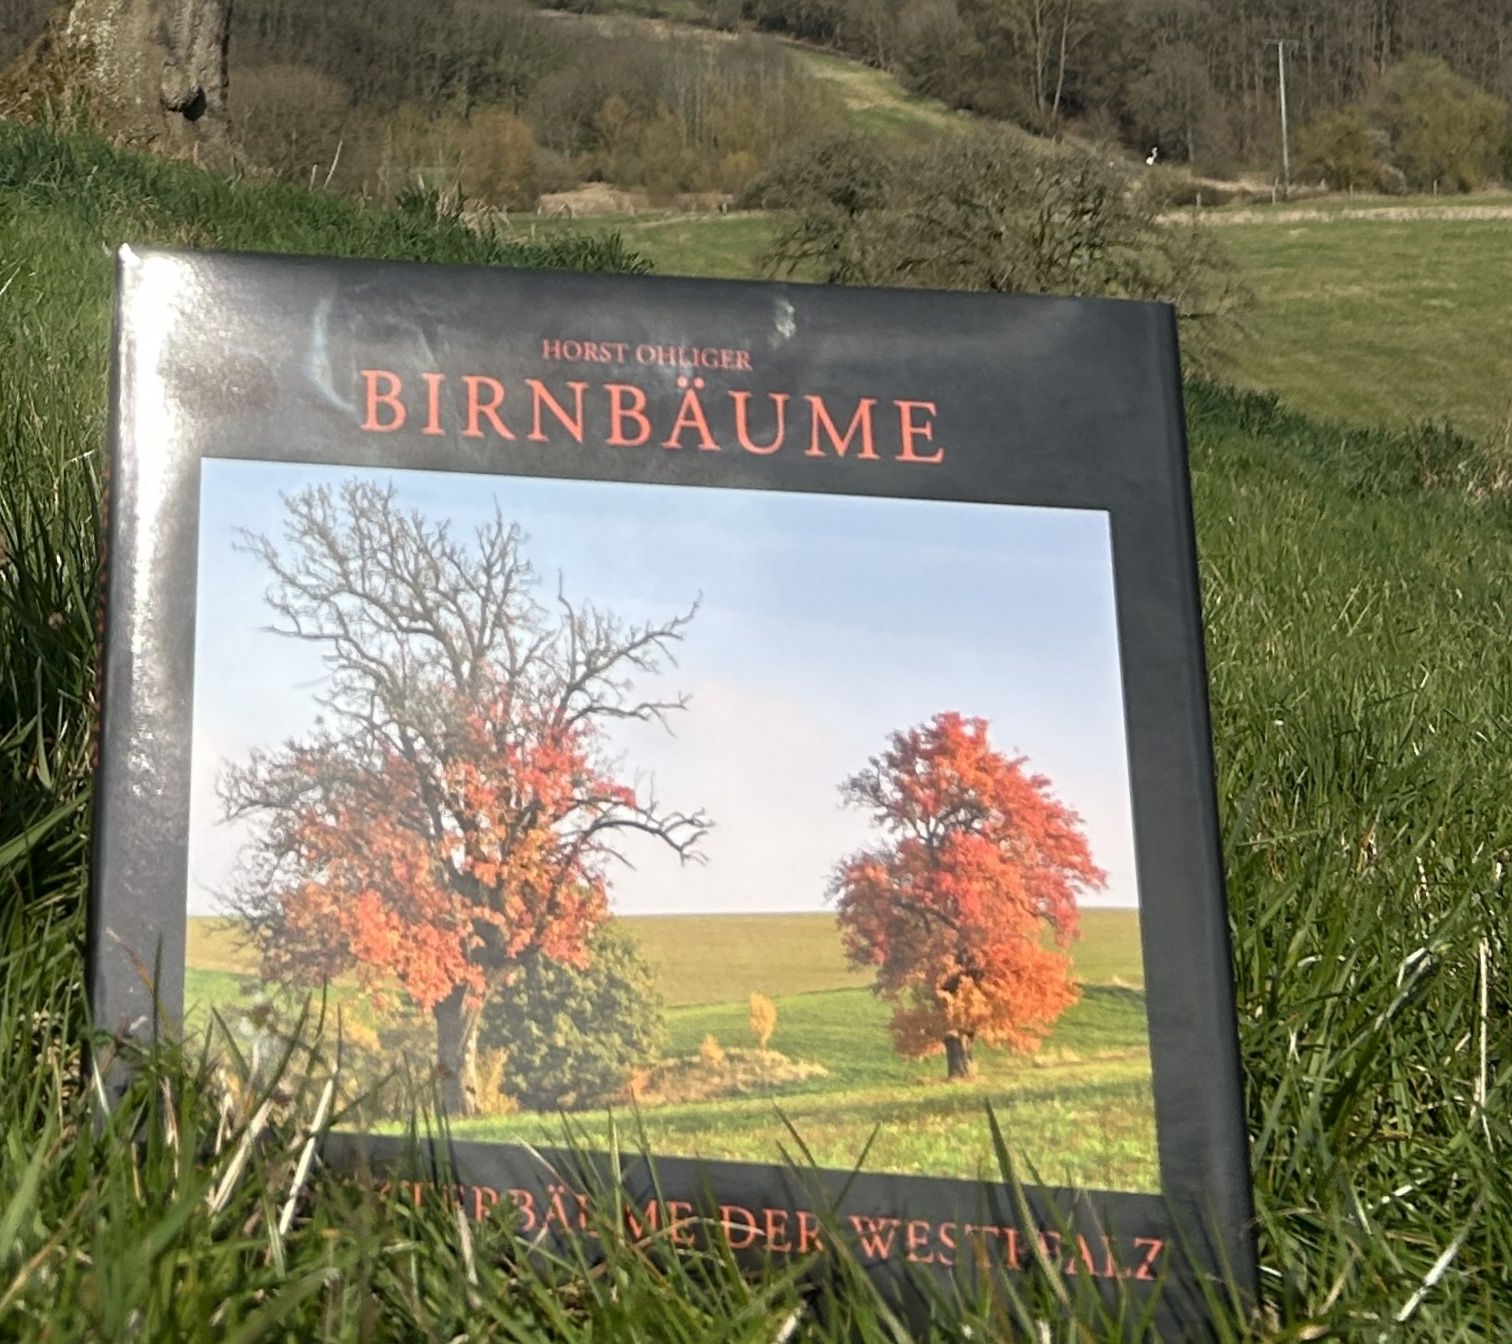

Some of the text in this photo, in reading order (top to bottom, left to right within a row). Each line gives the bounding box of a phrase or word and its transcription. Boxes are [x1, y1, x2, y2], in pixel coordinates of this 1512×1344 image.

[541, 337, 753, 372] HORST OHLIGER
[359, 368, 945, 464] BIRNBÄUME
[719, 1205, 824, 1254] DER
